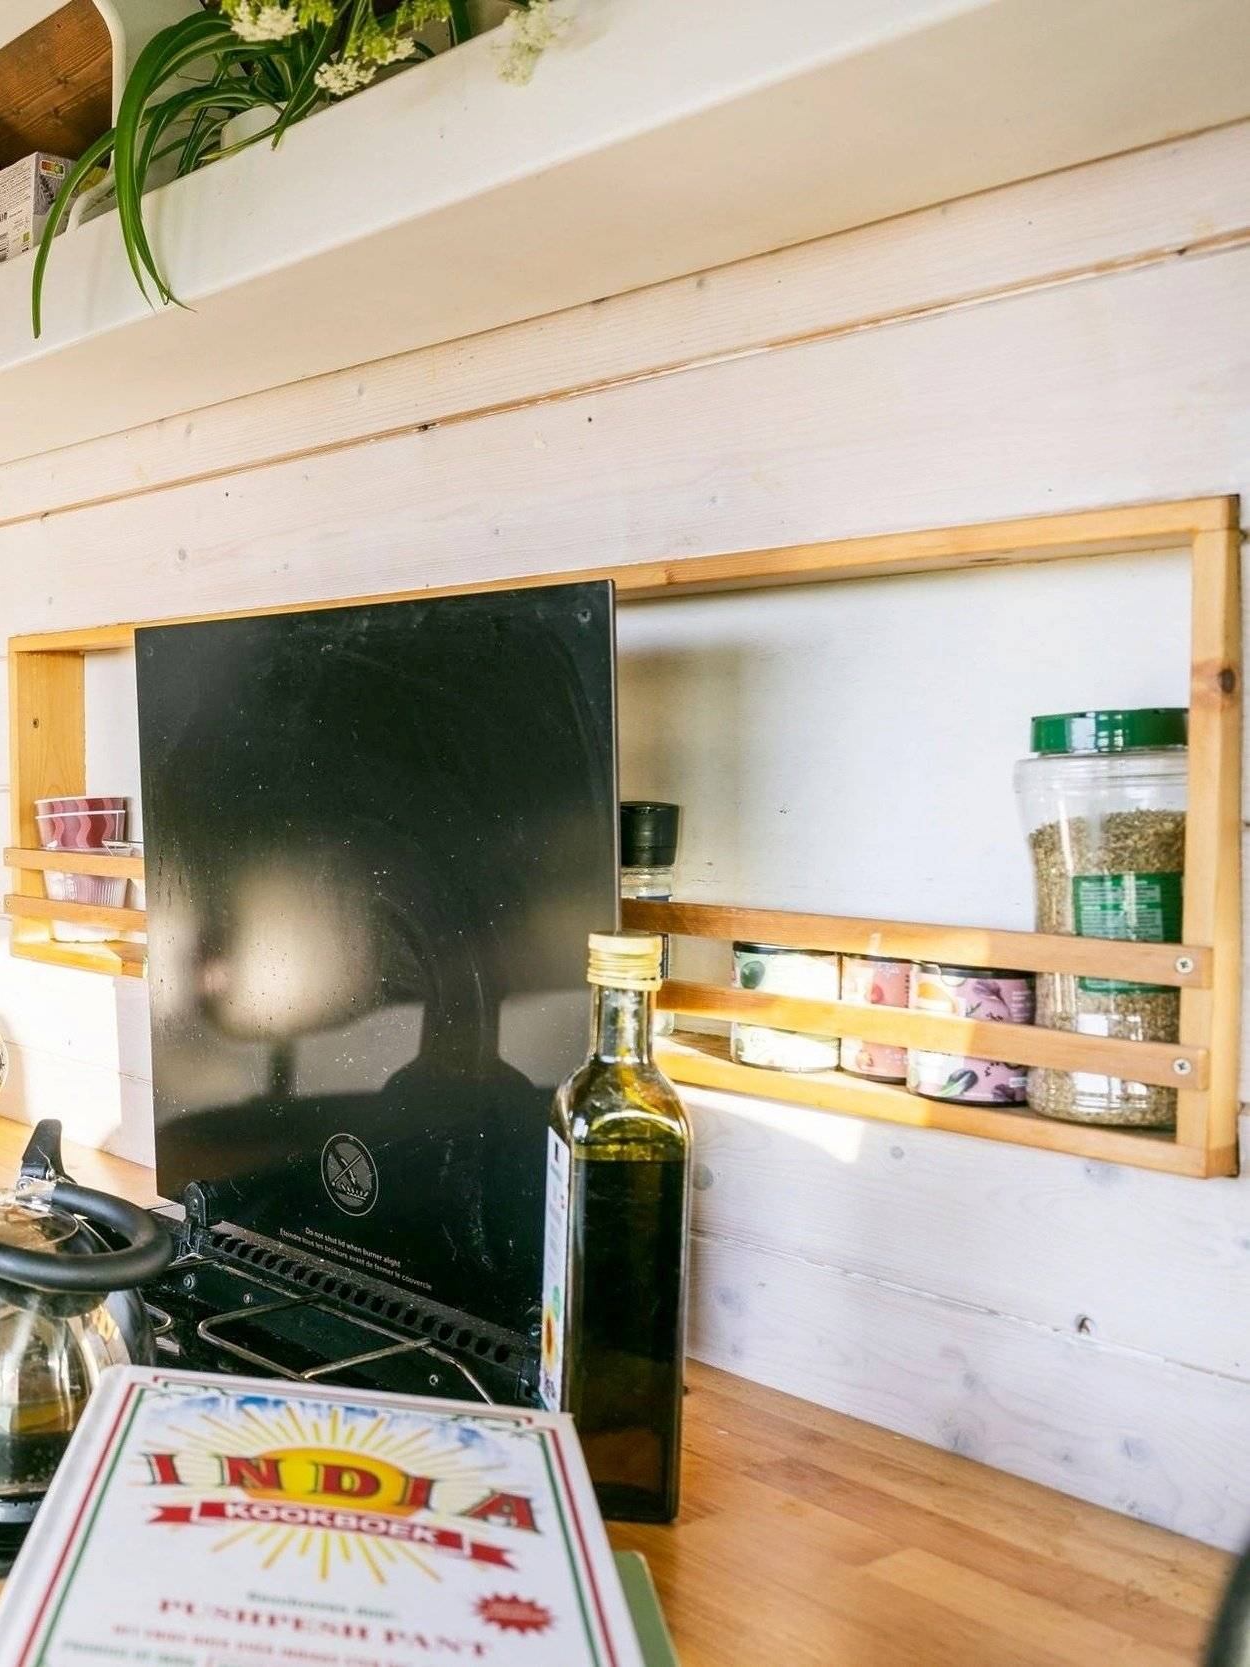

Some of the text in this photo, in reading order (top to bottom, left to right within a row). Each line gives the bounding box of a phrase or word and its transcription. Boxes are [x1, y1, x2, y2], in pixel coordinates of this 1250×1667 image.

[363, 1247, 383, 1260] burner
[144, 1452, 543, 1535] INDIA
[224, 1501, 440, 1545] KOOKBOEK
